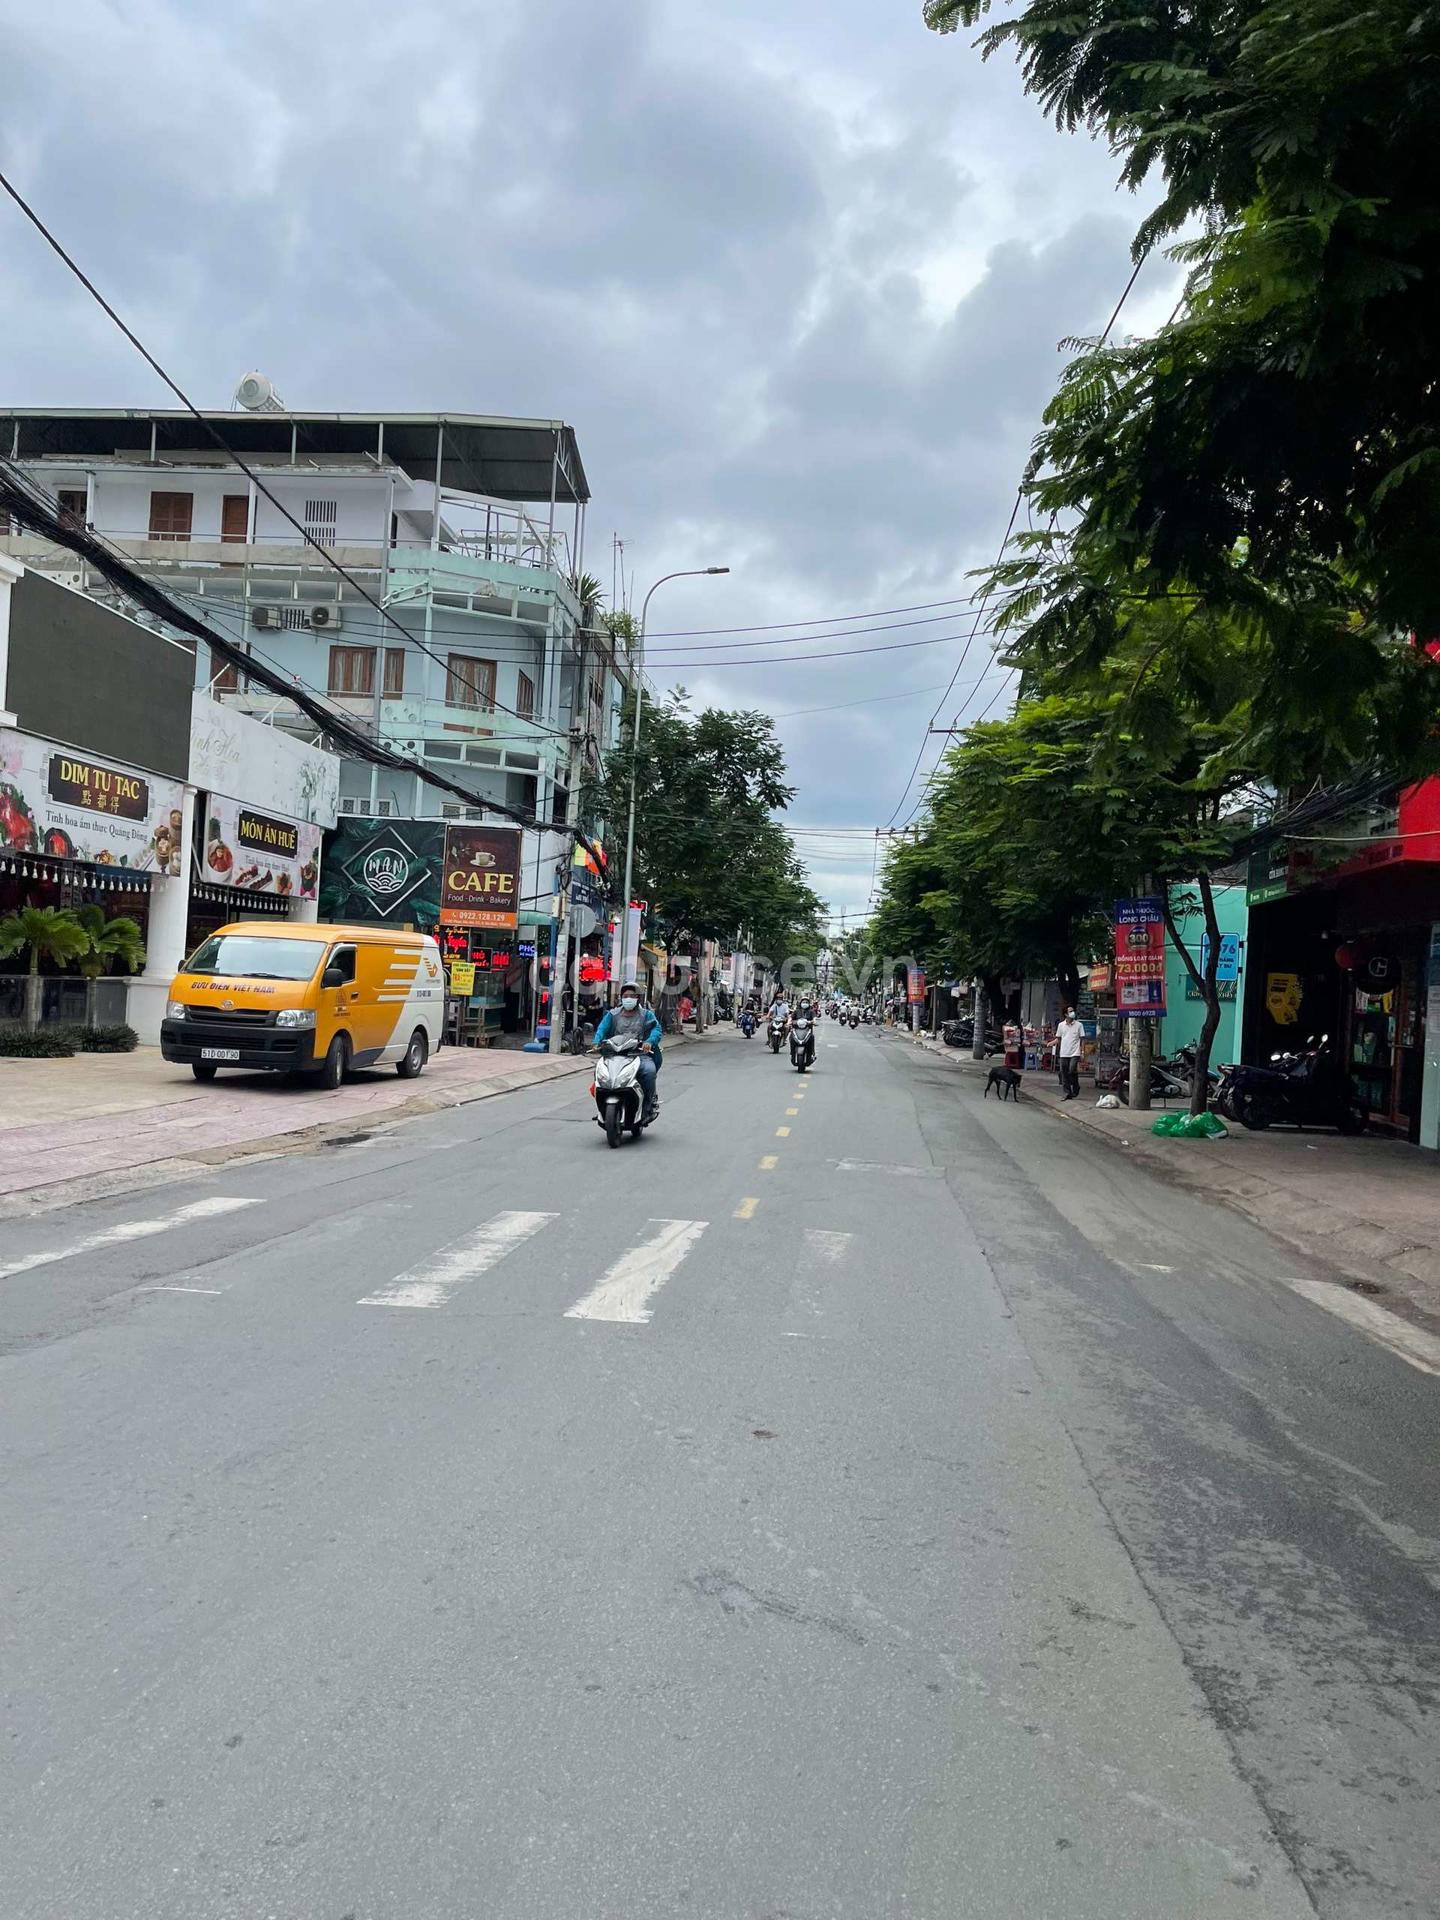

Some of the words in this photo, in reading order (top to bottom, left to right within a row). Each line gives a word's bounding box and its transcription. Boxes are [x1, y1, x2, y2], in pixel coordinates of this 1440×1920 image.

[60, 760, 89, 786] DIM
[115, 776, 140, 800] TAC
[65, 814, 78, 827] hoa
[241, 818, 263, 841] MÓN
[278, 828, 296, 849] HUẾ
[448, 870, 514, 894] CAFE
[448, 893, 464, 902] Food
[468, 894, 484, 904] Drink
[489, 895, 511, 906] Bakery
[1119, 915, 1139, 924] LONG
[1129, 932, 1149, 943] 300
